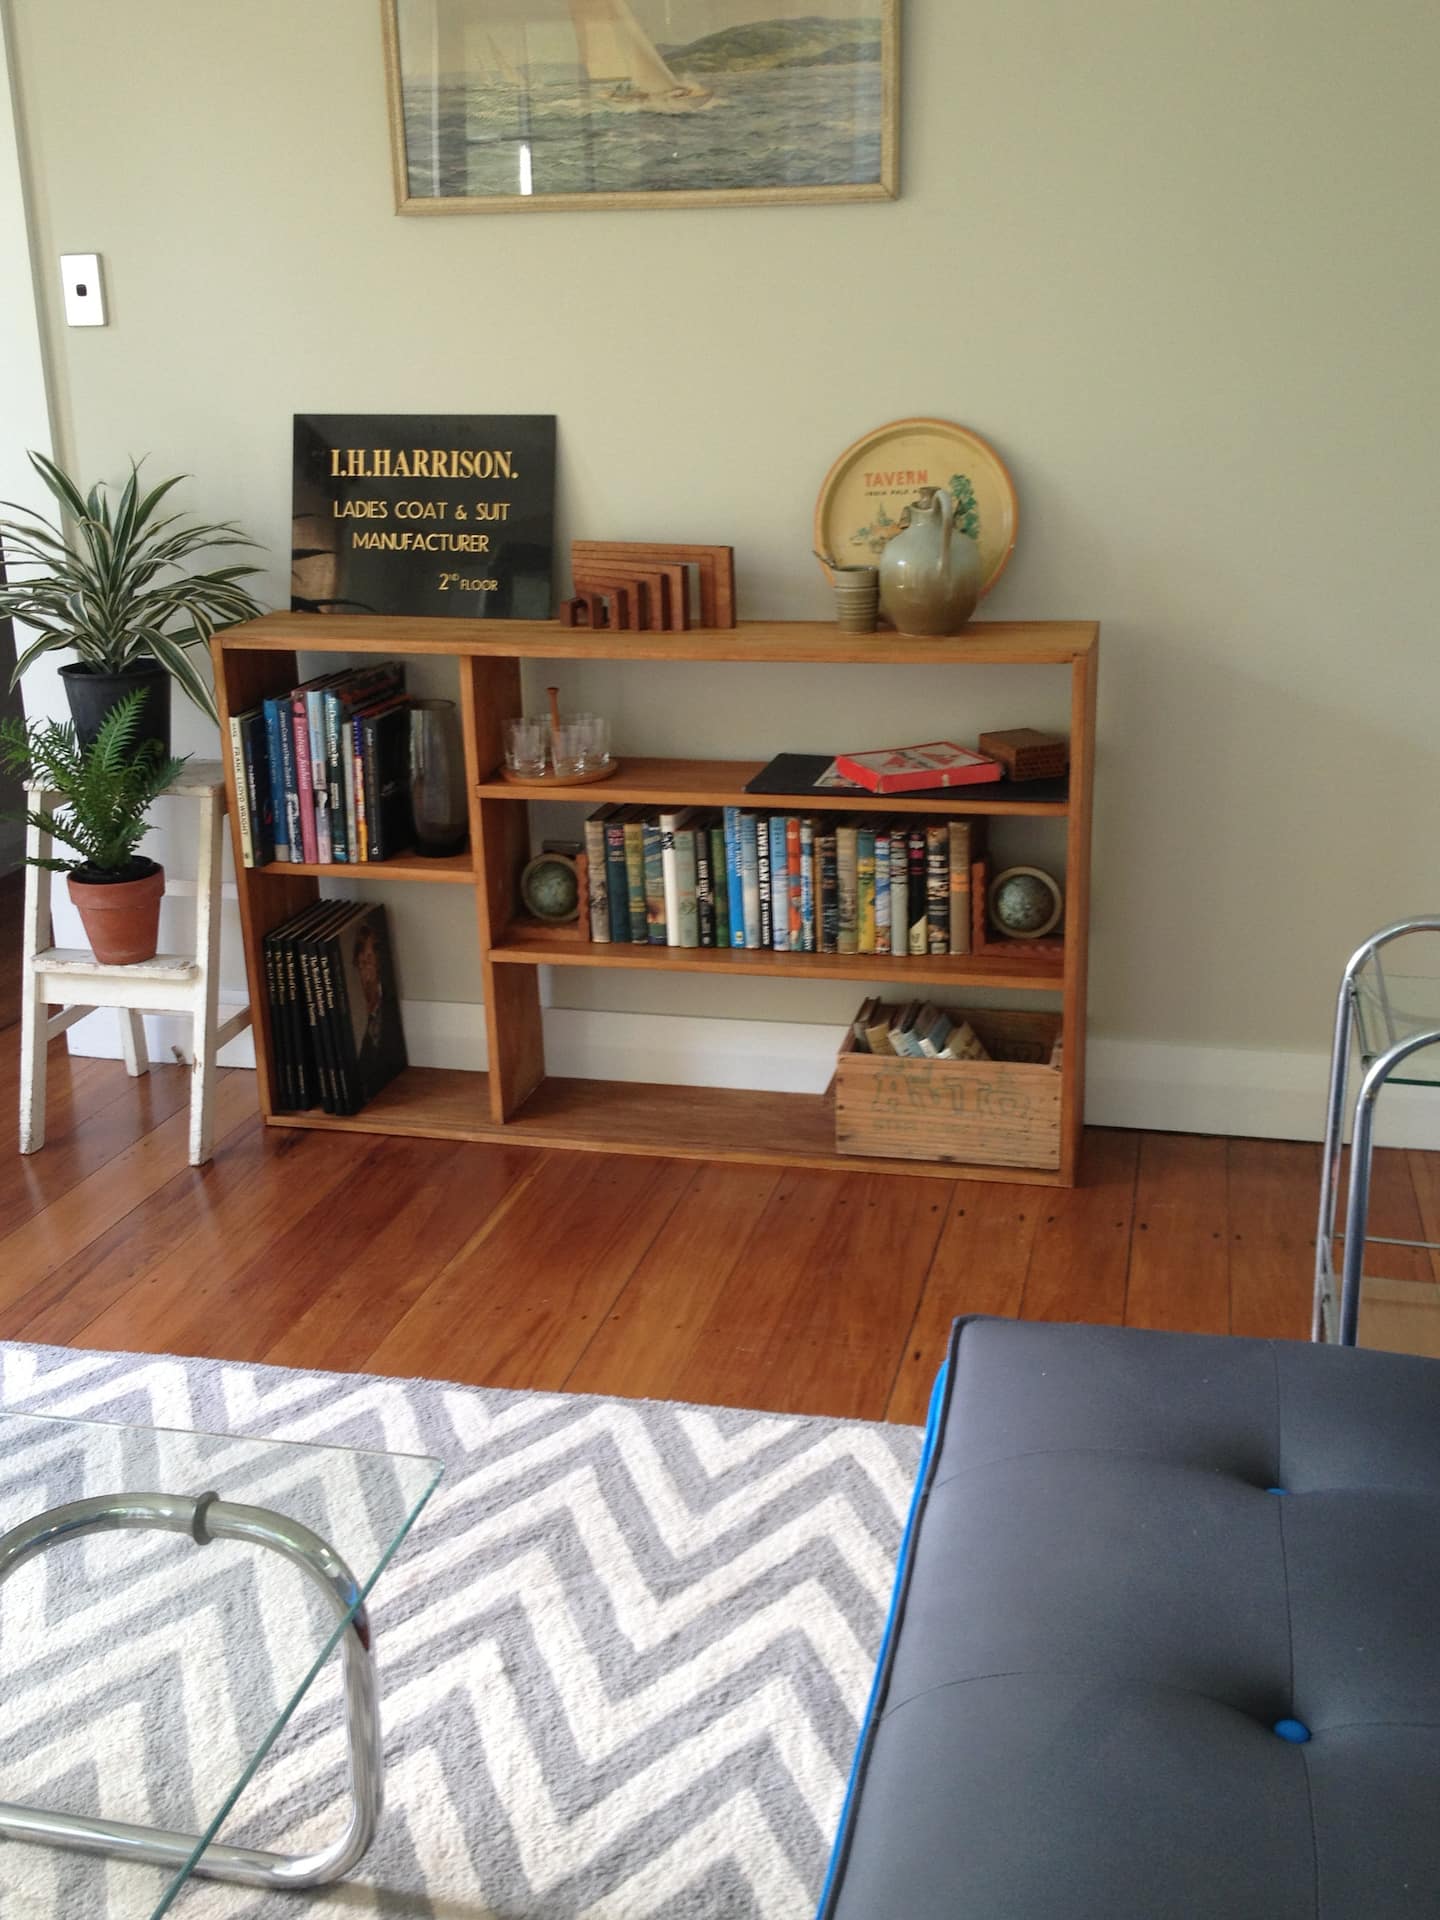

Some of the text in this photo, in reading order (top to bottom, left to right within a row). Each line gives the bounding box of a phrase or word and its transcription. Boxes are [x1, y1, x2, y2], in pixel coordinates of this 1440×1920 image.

[331, 449, 519, 479] I.H.HARRISON.
[863, 469, 929, 488] TAVERN
[333, 500, 511, 521] LADIES COAT & SUIT
[352, 532, 489, 552] MANUFACTURER
[459, 579, 498, 591] FLOOR
[234, 746, 242, 772] FRANK
[237, 776, 245, 802] LLOYD
[240, 805, 248, 835] WRIGHT
[758, 822, 768, 856] KIWIS
[759, 858, 770, 881] CAN
[760, 882, 770, 901] FLY
